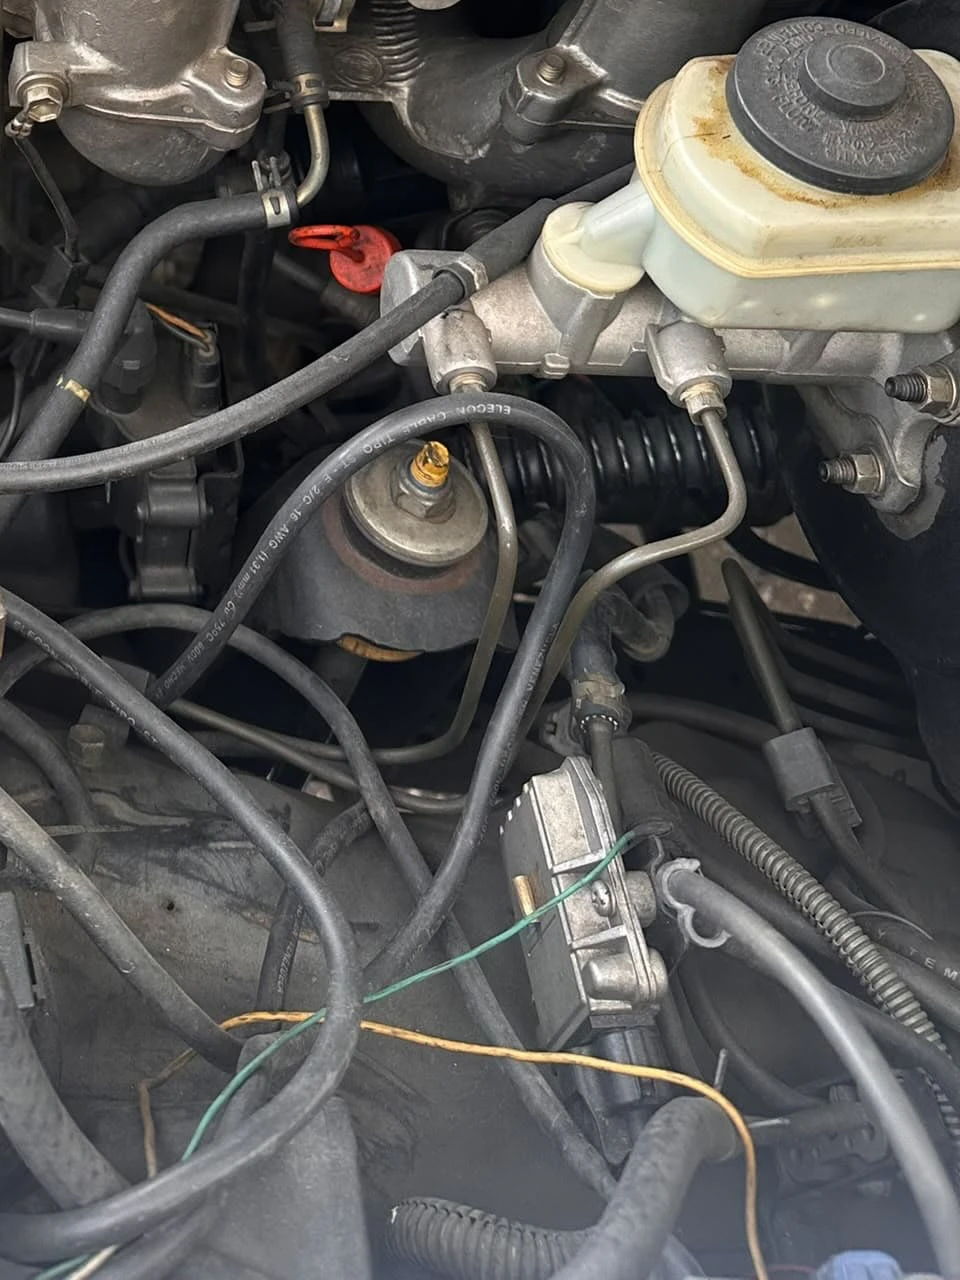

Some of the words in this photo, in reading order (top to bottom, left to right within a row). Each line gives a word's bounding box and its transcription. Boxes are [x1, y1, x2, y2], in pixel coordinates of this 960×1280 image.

[402, 411, 447, 434] CABLE
[361, 433, 396, 455] TIPO
[302, 484, 321, 505] 2/C
[289, 508, 302, 522] 16
[268, 523, 290, 550] AWG
